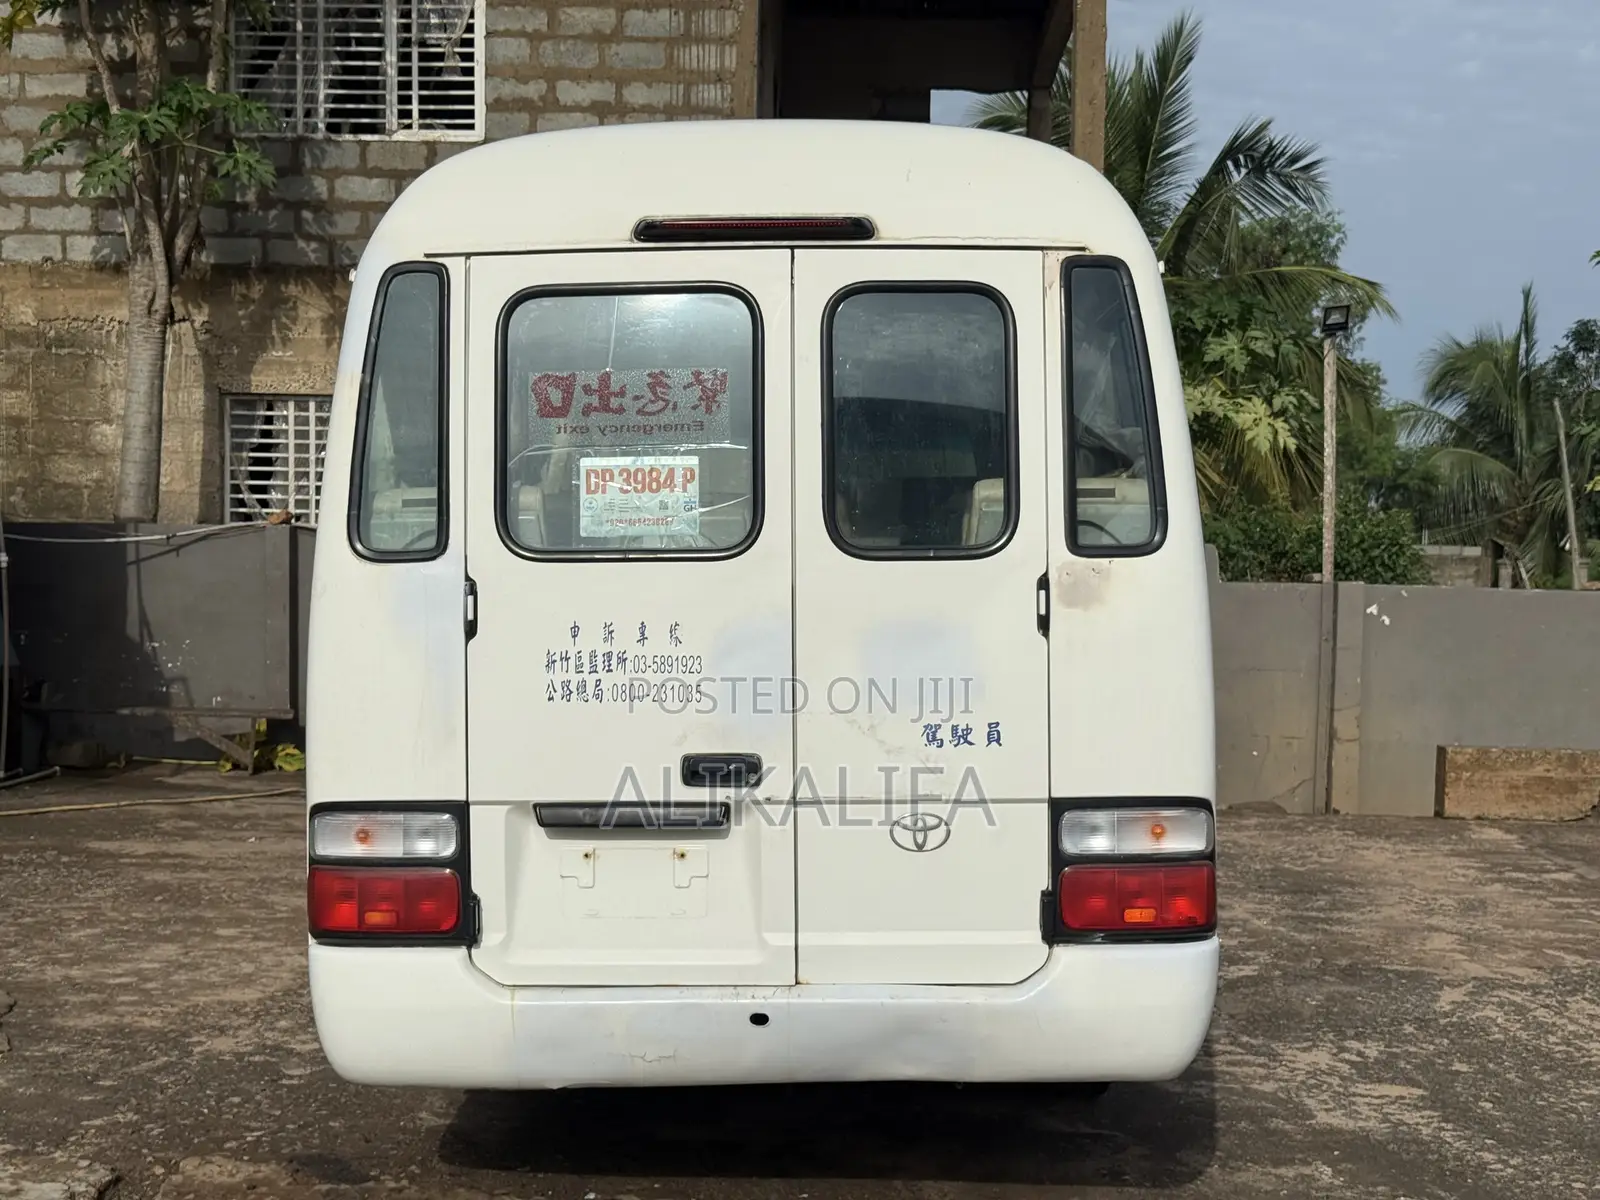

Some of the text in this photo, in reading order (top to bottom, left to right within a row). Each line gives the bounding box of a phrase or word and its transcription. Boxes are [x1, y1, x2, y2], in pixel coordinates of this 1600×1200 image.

[618, 466, 675, 495] 3984
[920, 721, 1003, 748] 駕駛員
